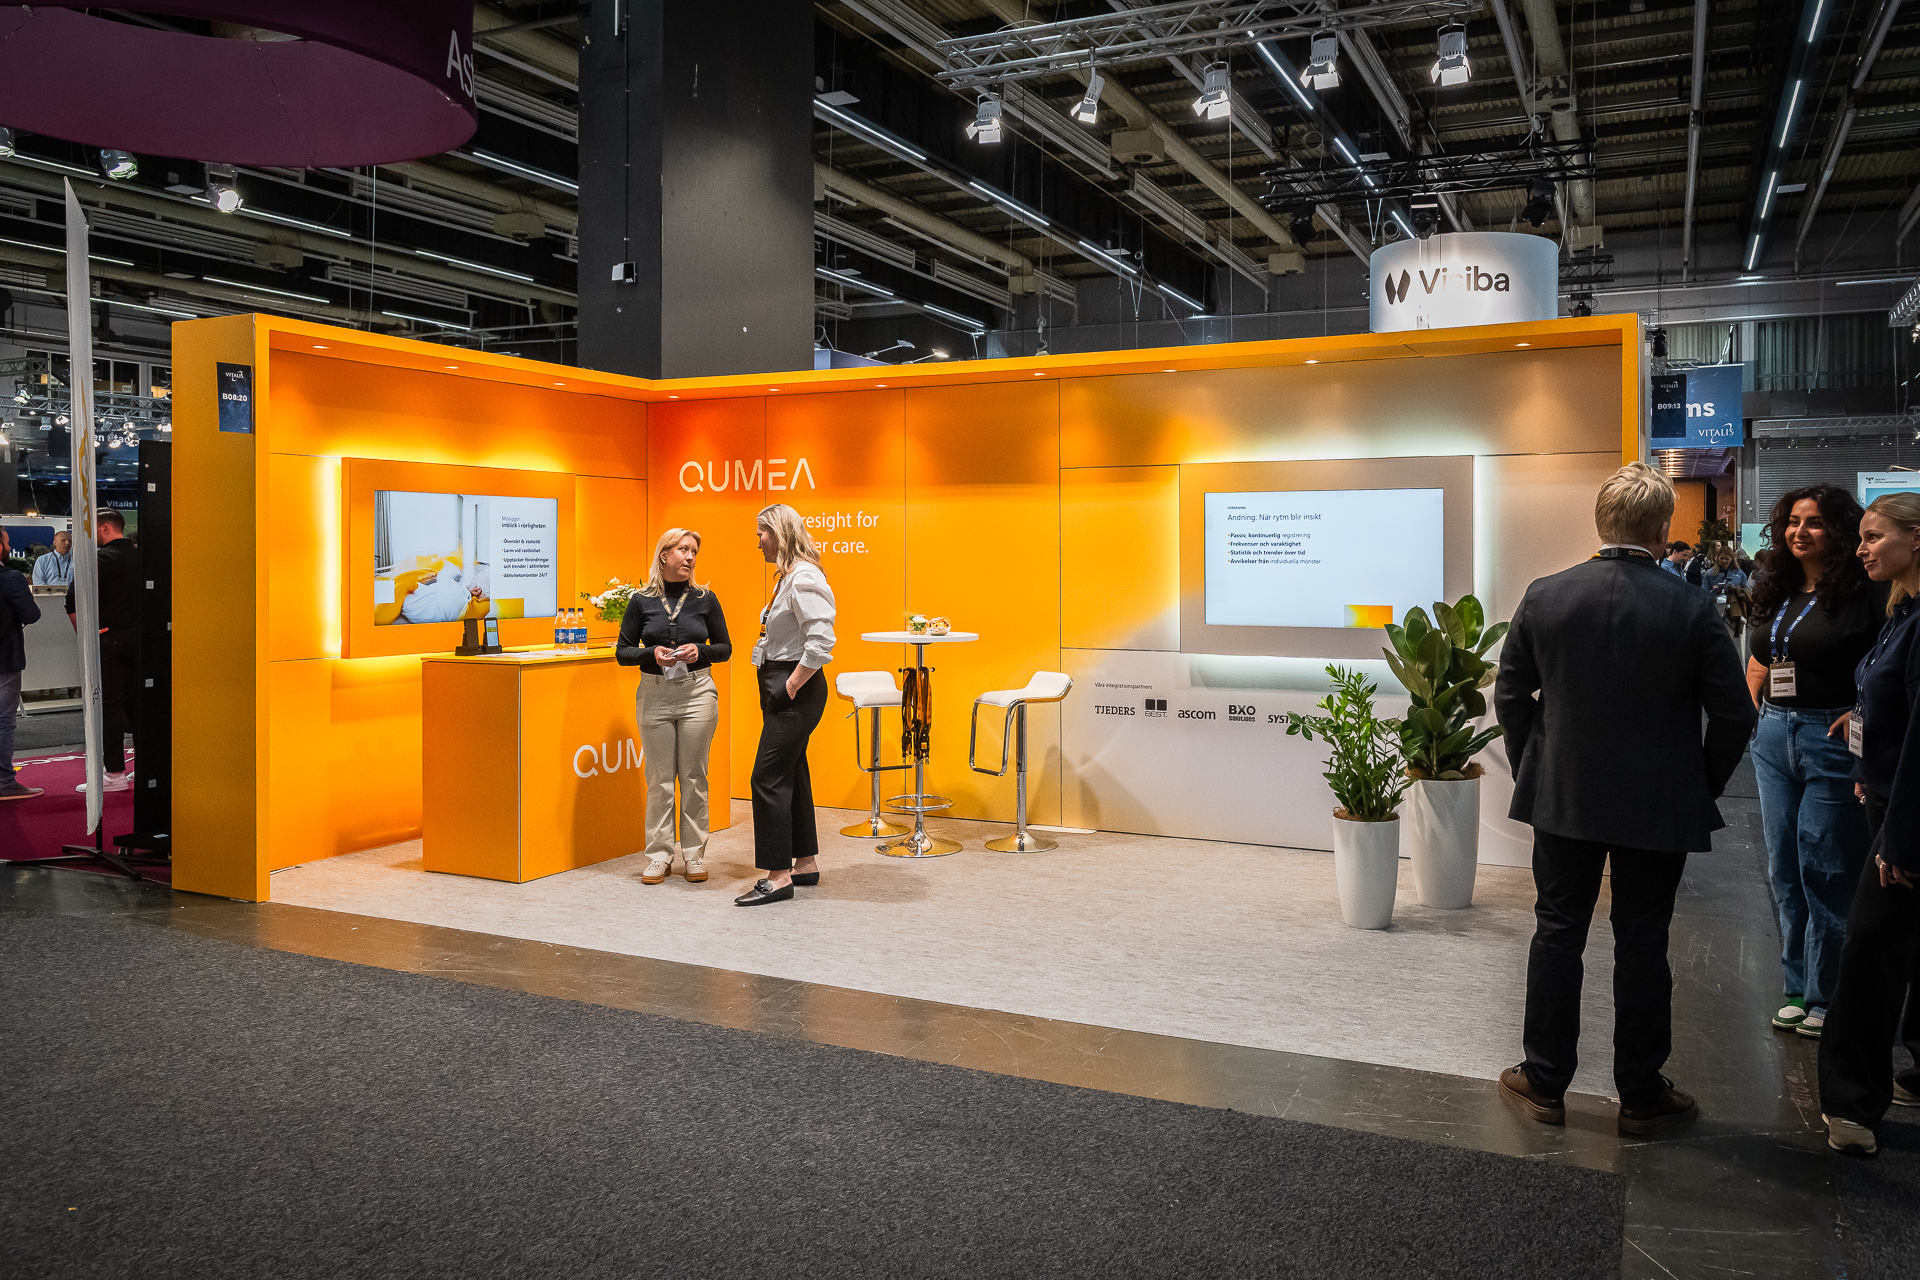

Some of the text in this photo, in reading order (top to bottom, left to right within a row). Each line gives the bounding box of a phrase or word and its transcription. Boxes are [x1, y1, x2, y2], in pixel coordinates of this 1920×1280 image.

[222, 392, 248, 402] B08:20
[1698, 425, 1735, 441] VITALIS
[679, 457, 816, 493] QUMEA
[856, 510, 880, 528] for
[1227, 512, 1322, 522] Andning: När rytm blir insikt
[1248, 532, 1281, 540] kontinuerlig
[1281, 532, 1311, 540] registrering
[832, 541, 869, 554] care.
[1094, 705, 1136, 716] TJEDERS
[1177, 709, 1216, 720] ascom
[1228, 704, 1256, 716] BXO
